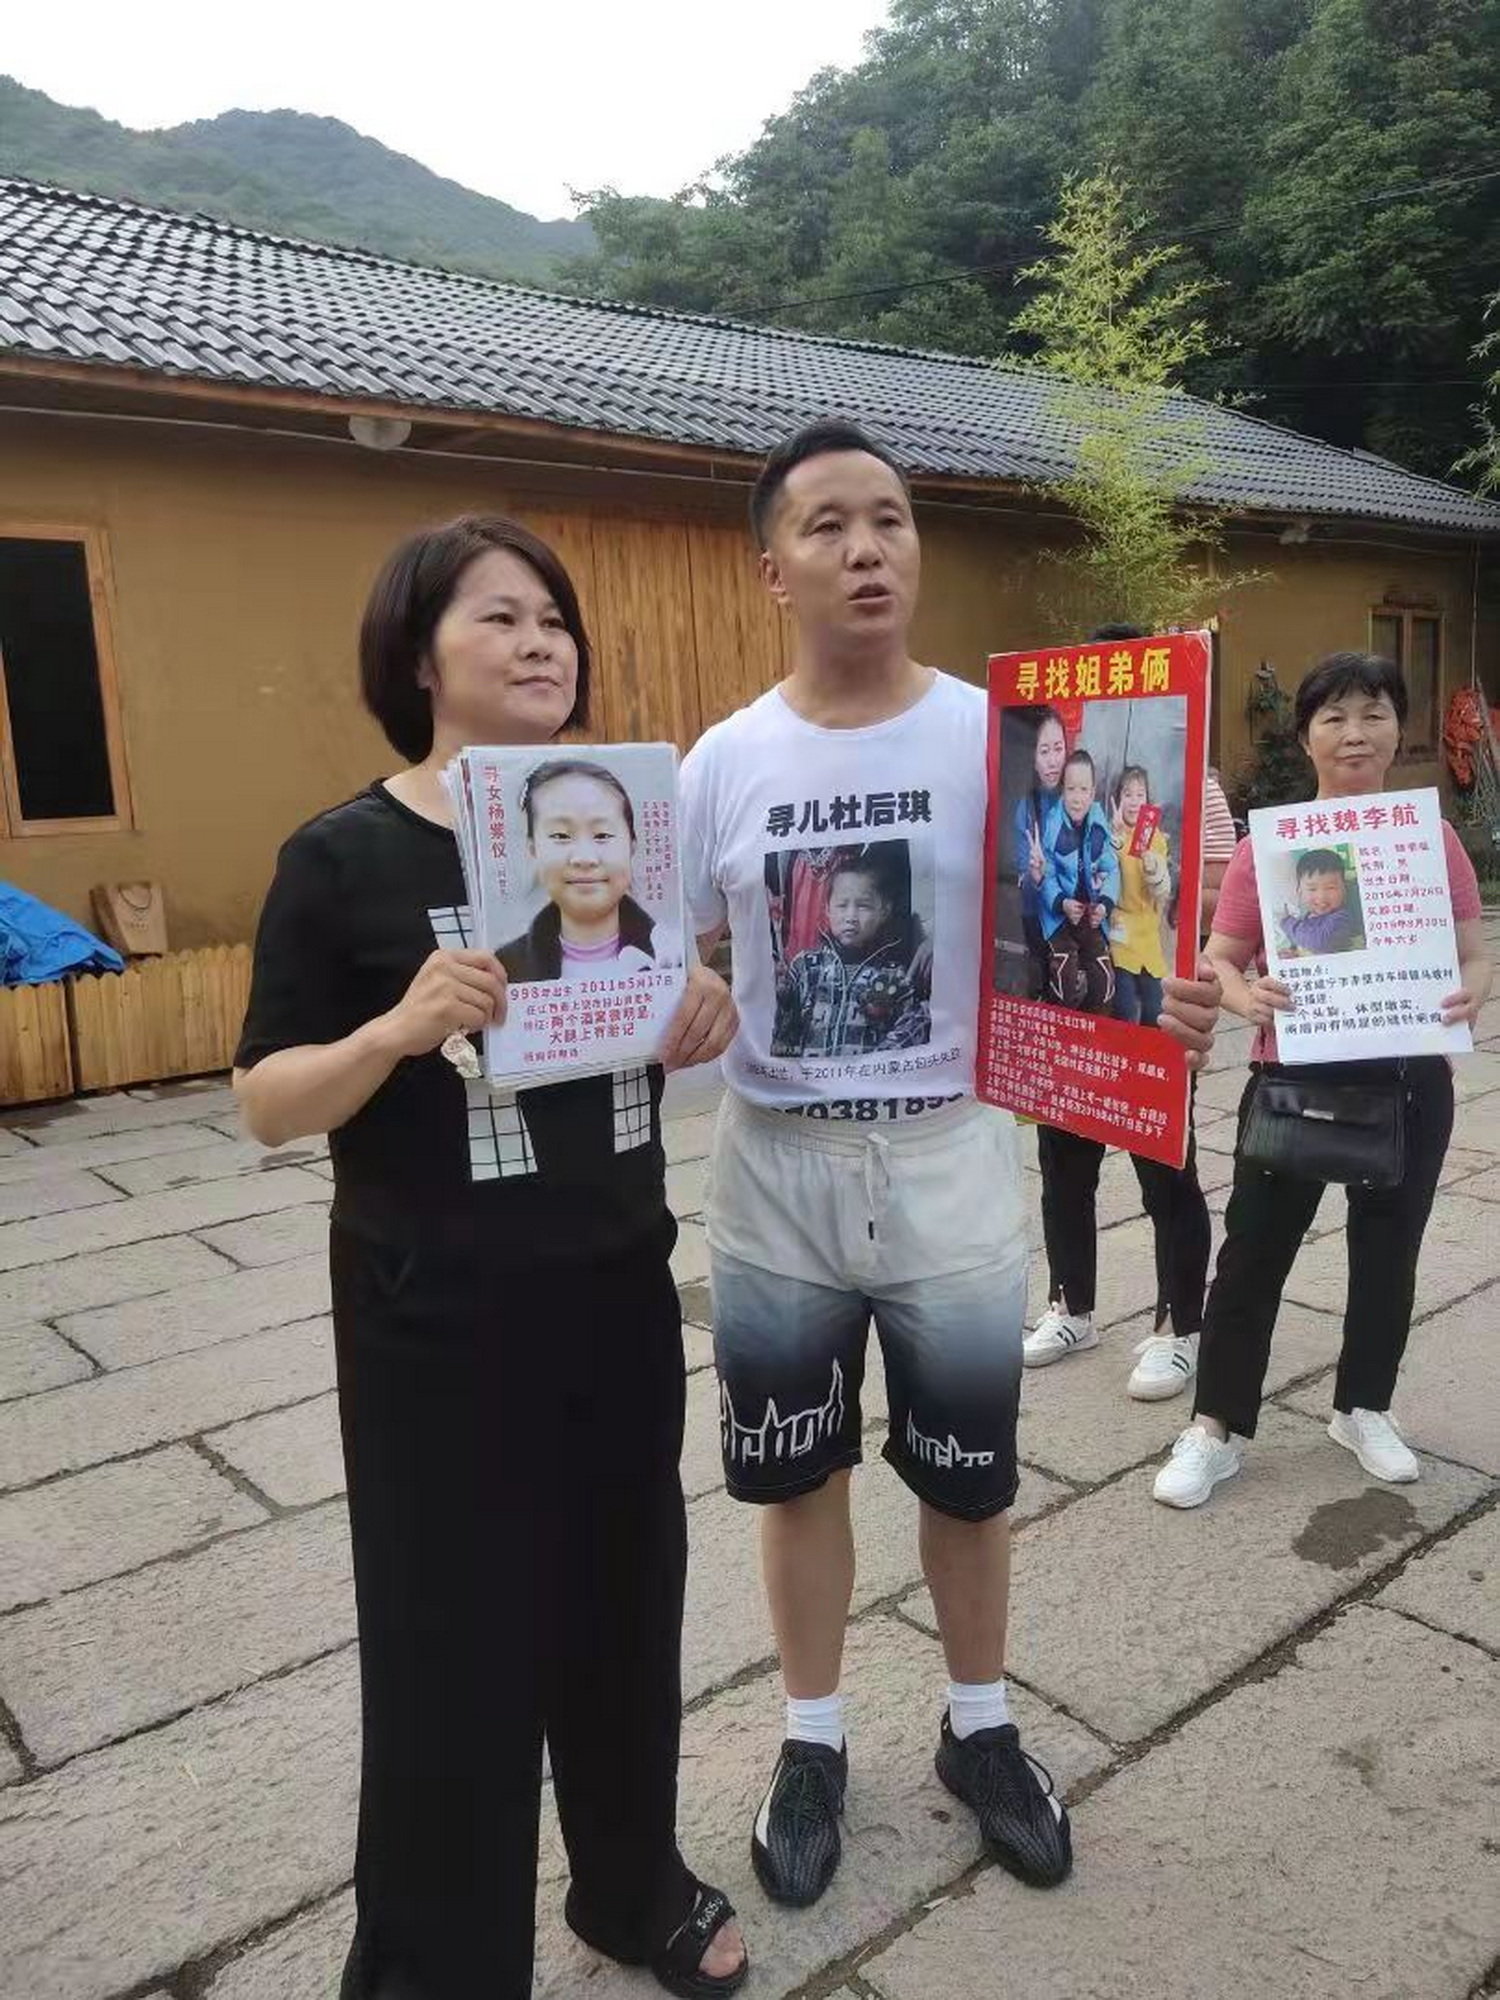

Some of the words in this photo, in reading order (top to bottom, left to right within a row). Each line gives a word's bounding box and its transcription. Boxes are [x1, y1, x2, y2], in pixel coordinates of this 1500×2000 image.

[1016, 647, 1171, 700] 寻找姐弟俩
[765, 789, 932, 838] 寻儿杜后琪
[1275, 803, 1420, 840] 寻找魏李航
